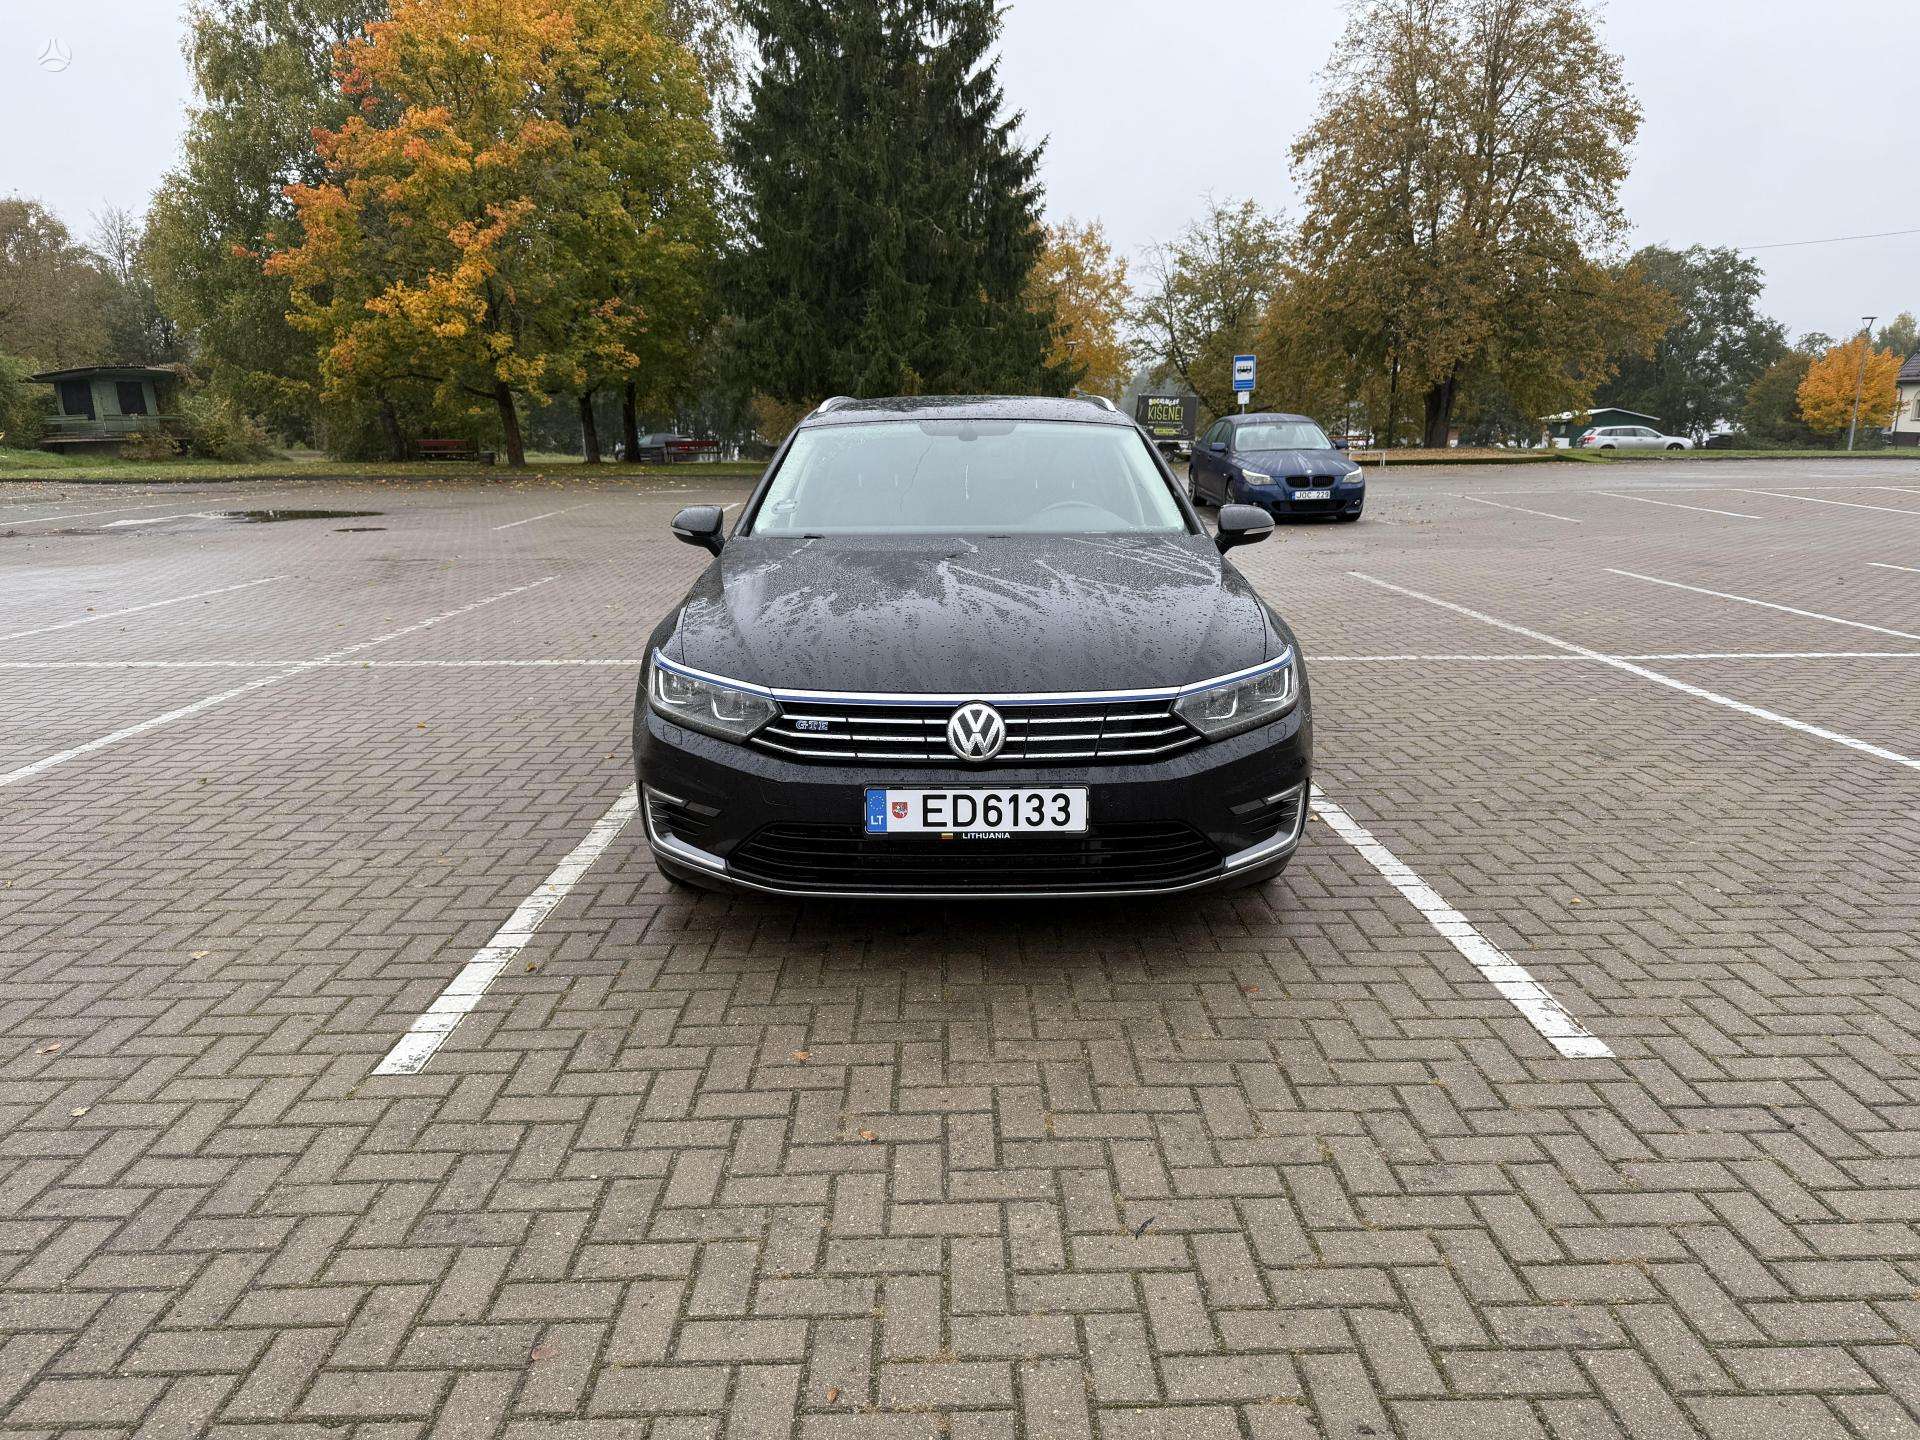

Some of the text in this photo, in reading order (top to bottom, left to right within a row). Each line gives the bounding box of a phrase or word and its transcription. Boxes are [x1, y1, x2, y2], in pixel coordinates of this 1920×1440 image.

[795, 720, 829, 730] GTE
[922, 793, 1071, 828] ED6133
[870, 815, 884, 825] LT
